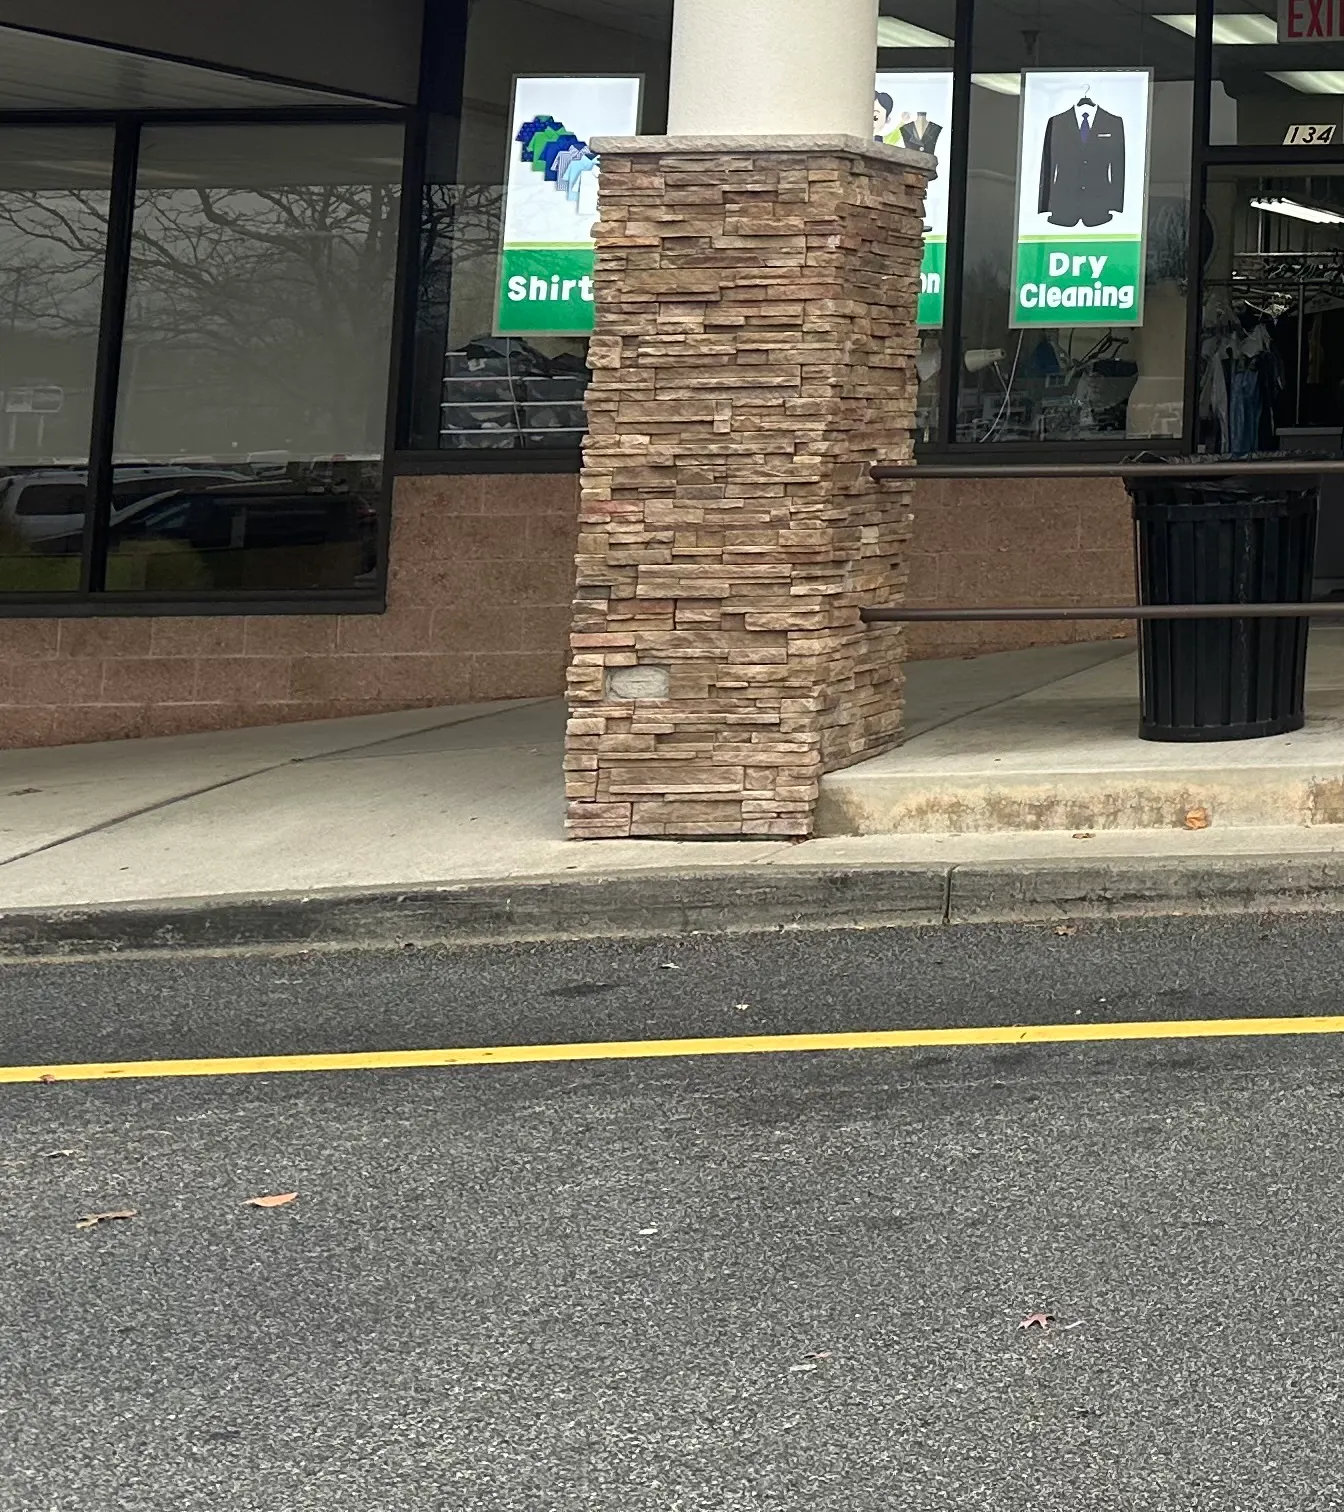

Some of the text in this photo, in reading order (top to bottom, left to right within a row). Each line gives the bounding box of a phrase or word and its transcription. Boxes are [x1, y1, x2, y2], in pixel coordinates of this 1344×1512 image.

[1290, 126, 1333, 143] 134
[1048, 251, 1108, 278] Dry
[1019, 281, 1135, 309] Cleaning
